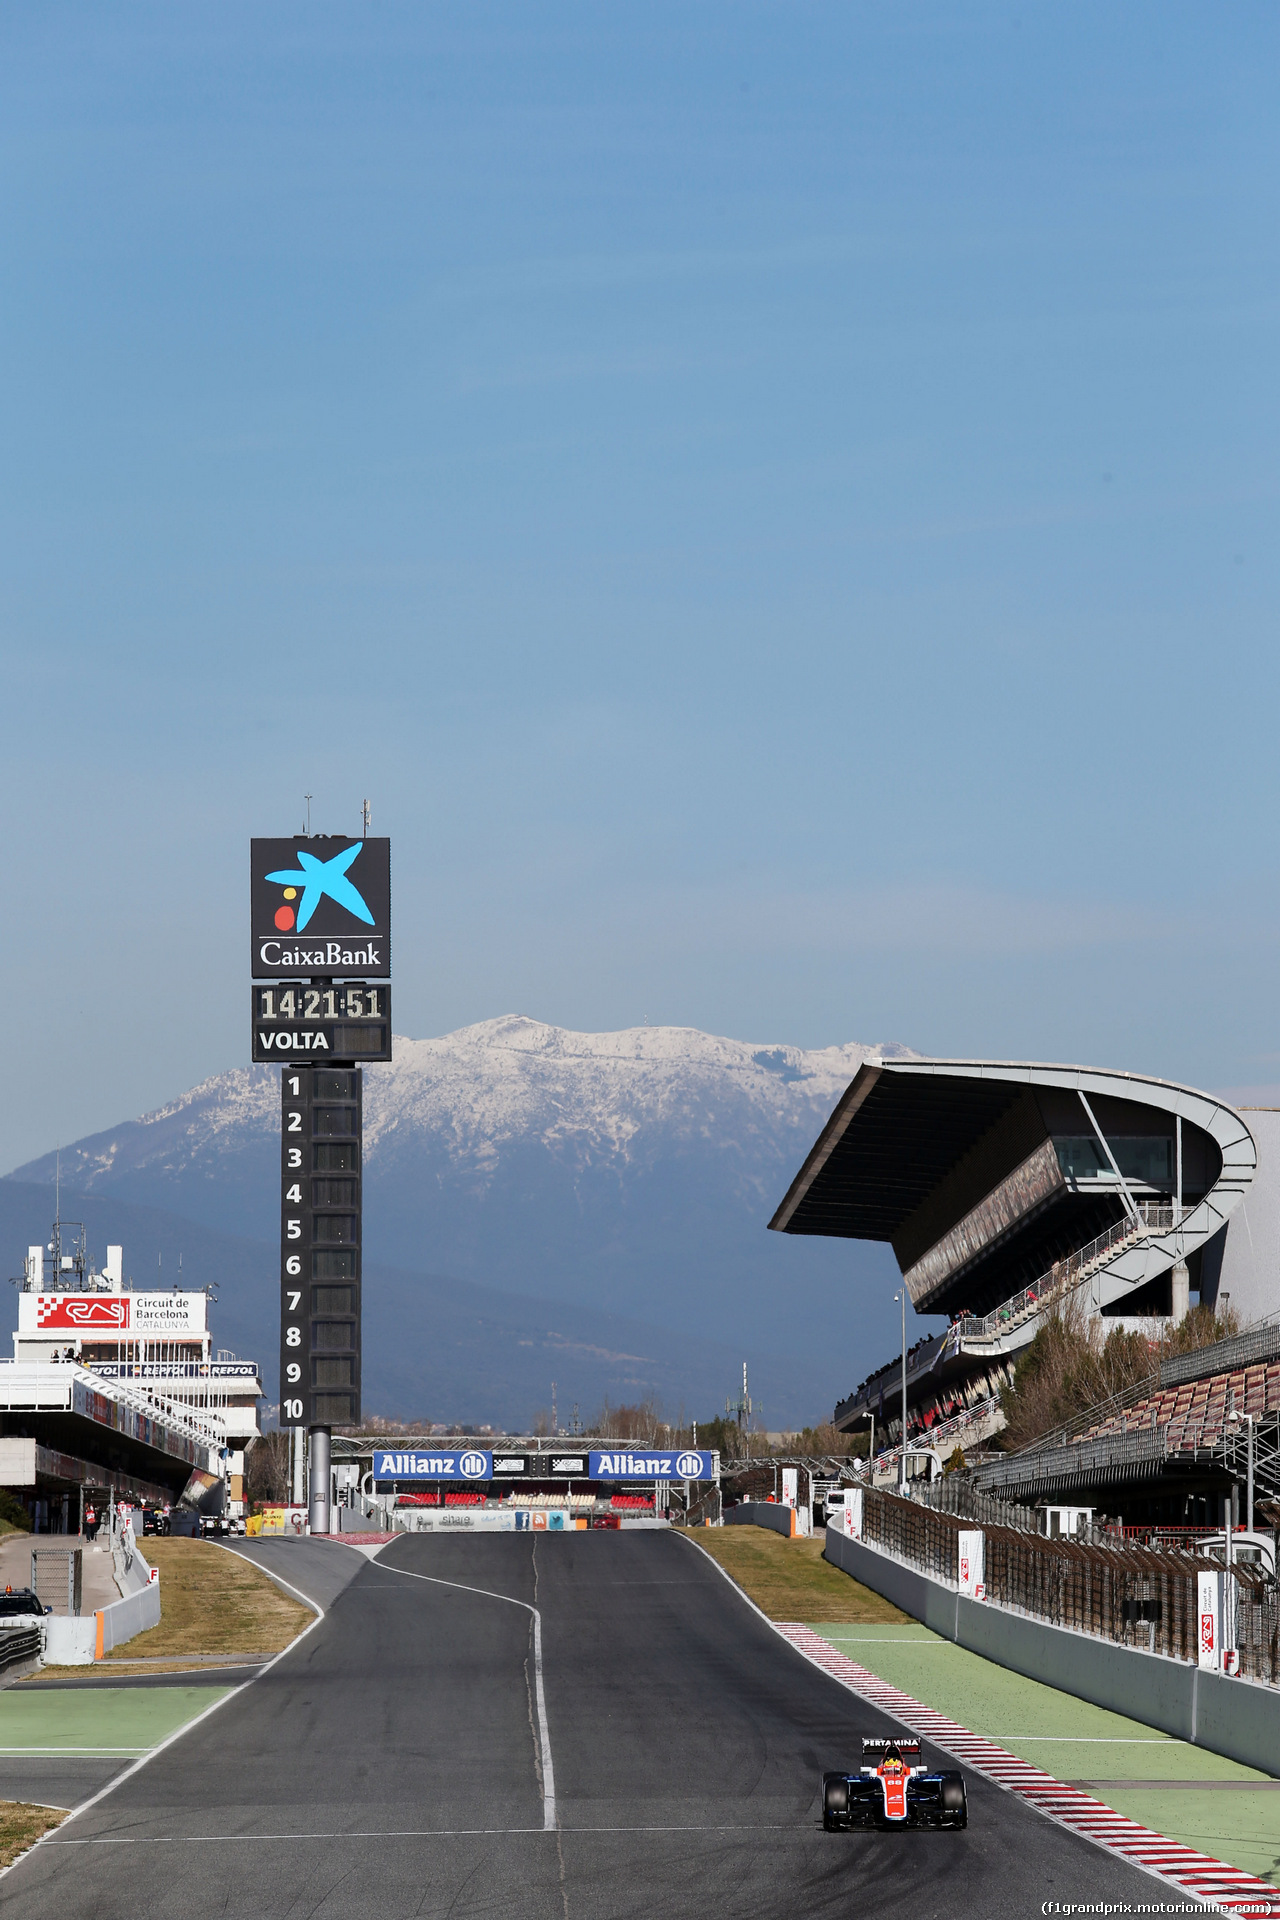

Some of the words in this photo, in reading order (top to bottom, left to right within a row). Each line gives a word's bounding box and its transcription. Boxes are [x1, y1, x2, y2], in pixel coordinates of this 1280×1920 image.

[260, 941, 381, 965] CaixaBank
[261, 989, 381, 1019] 14:21:51
[259, 1032, 329, 1049] VOLTA
[288, 1076, 300, 1095] 1
[287, 1112, 302, 1131] 2
[287, 1148, 302, 1167] 3
[286, 1184, 302, 1203] 4
[287, 1219, 301, 1239] 5
[286, 1255, 301, 1275] 6
[136, 1298, 178, 1308] Circuit
[177, 1298, 189, 1308] de
[286, 1291, 301, 1310] 7
[136, 1309, 189, 1319] Barcelona
[136, 1320, 190, 1329] CATALUNYA
[286, 1327, 301, 1347] 8
[92, 1366, 118, 1375] PSOL
[211, 1366, 254, 1375] REPSOL
[286, 1363, 301, 1382] 9
[283, 1398, 303, 1418] 10
[379, 1454, 455, 1474] Allianz
[597, 1454, 672, 1474] Allianz
[125, 1519, 131, 1527] F
[442, 1514, 471, 1524] share
[850, 1526, 856, 1535] F
[150, 1569, 158, 1580] F
[974, 1584, 984, 1597] F
[1223, 1651, 1236, 1671] F
[863, 1739, 919, 1747] PERTAMINA
